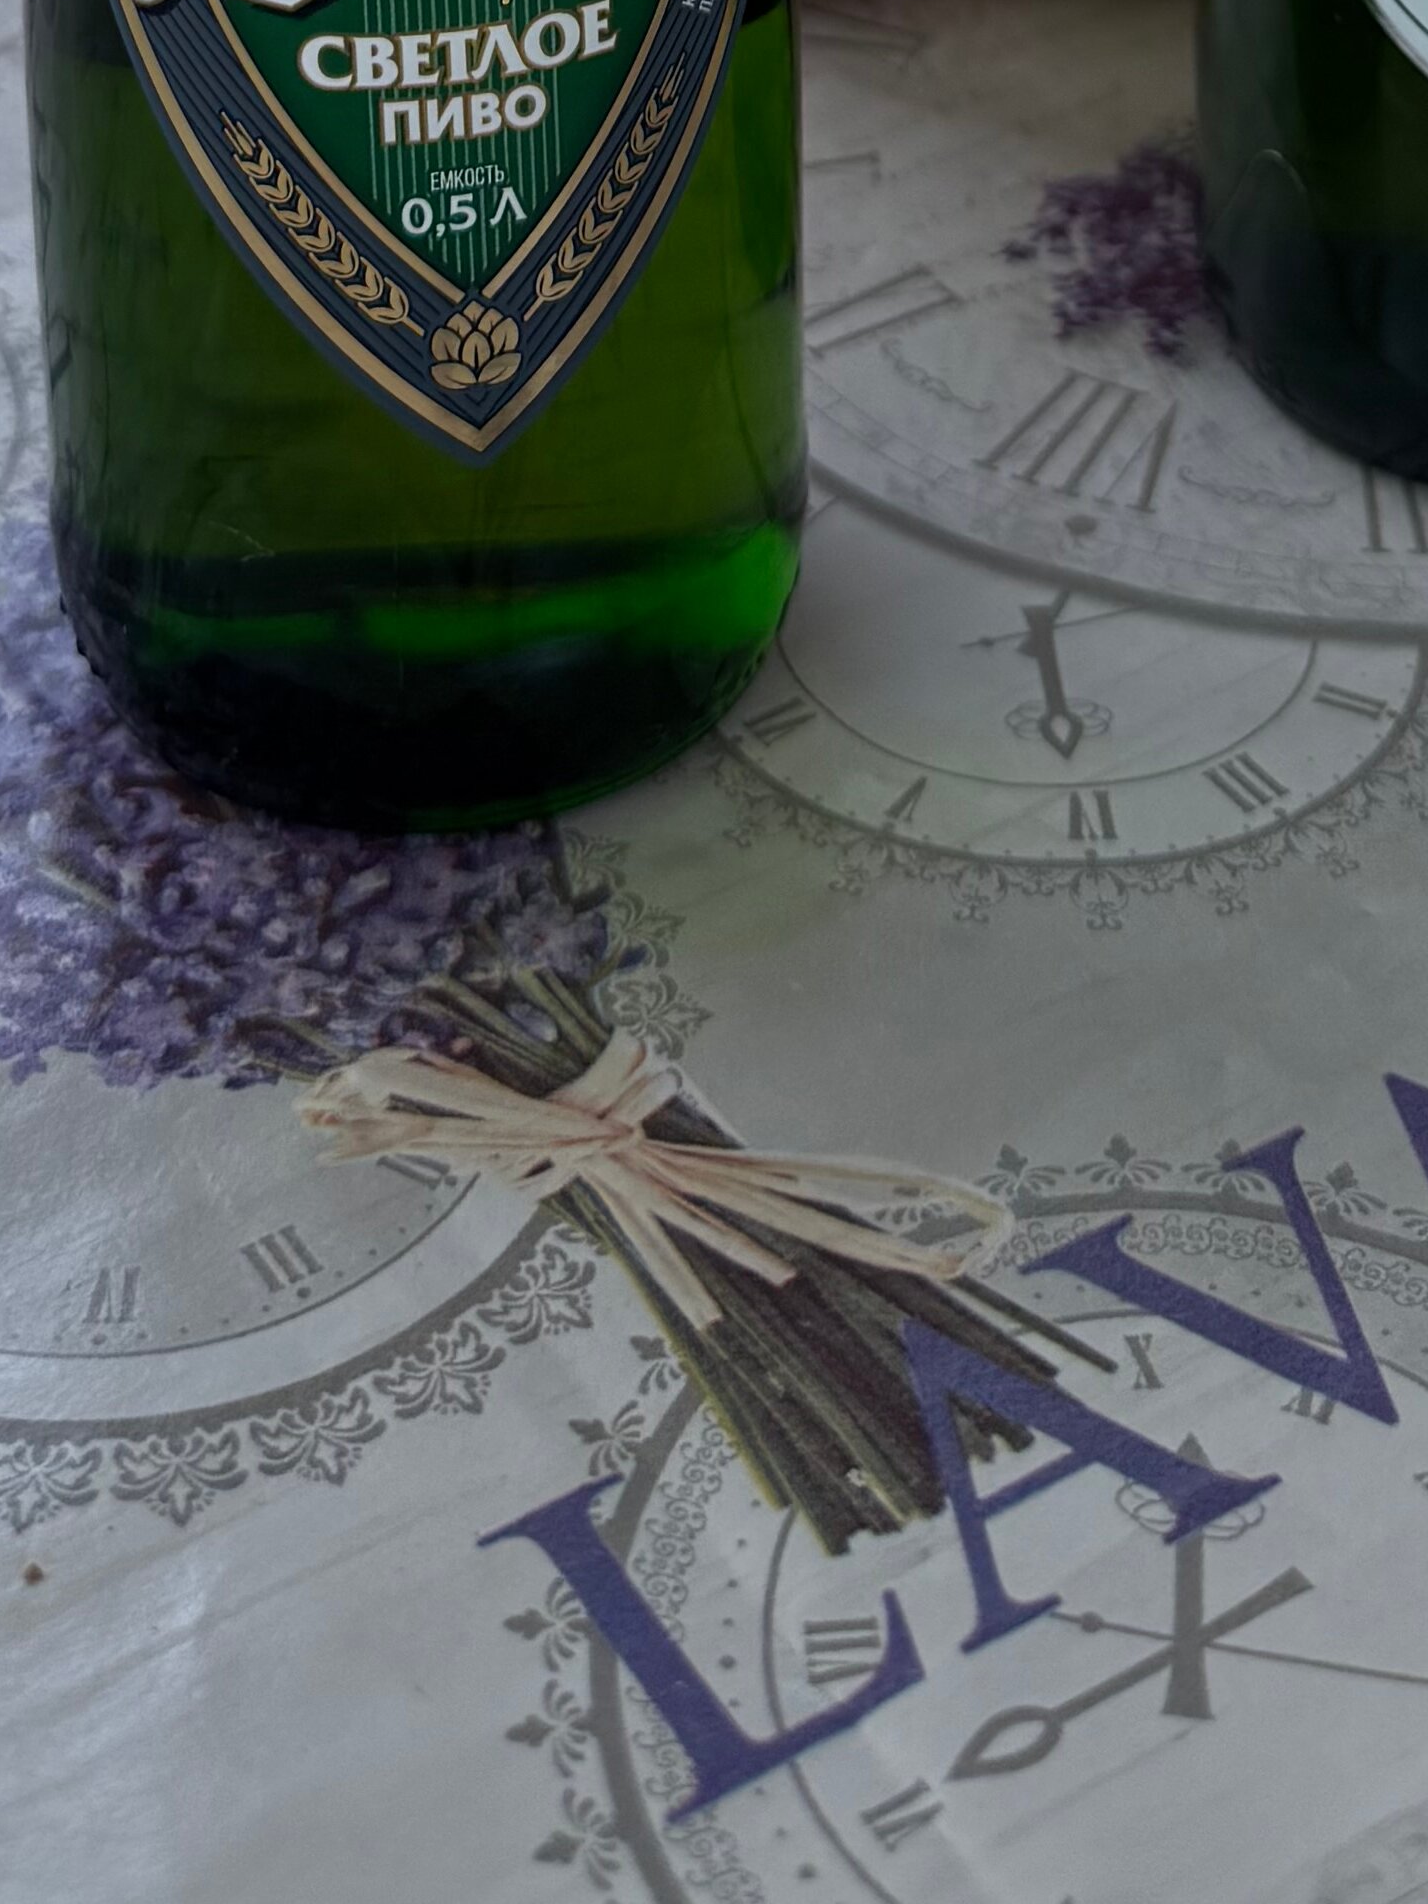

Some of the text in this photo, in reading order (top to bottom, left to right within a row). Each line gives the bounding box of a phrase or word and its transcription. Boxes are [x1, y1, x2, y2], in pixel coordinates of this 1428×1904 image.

[297, 0, 618, 92] СВЕТЛОЕ
[379, 86, 548, 146] ПИВО
[430, 166, 505, 192] ЕМКОСТЬ
[401, 187, 528, 238] 0,5 Л
[239, 1224, 325, 1293] III
